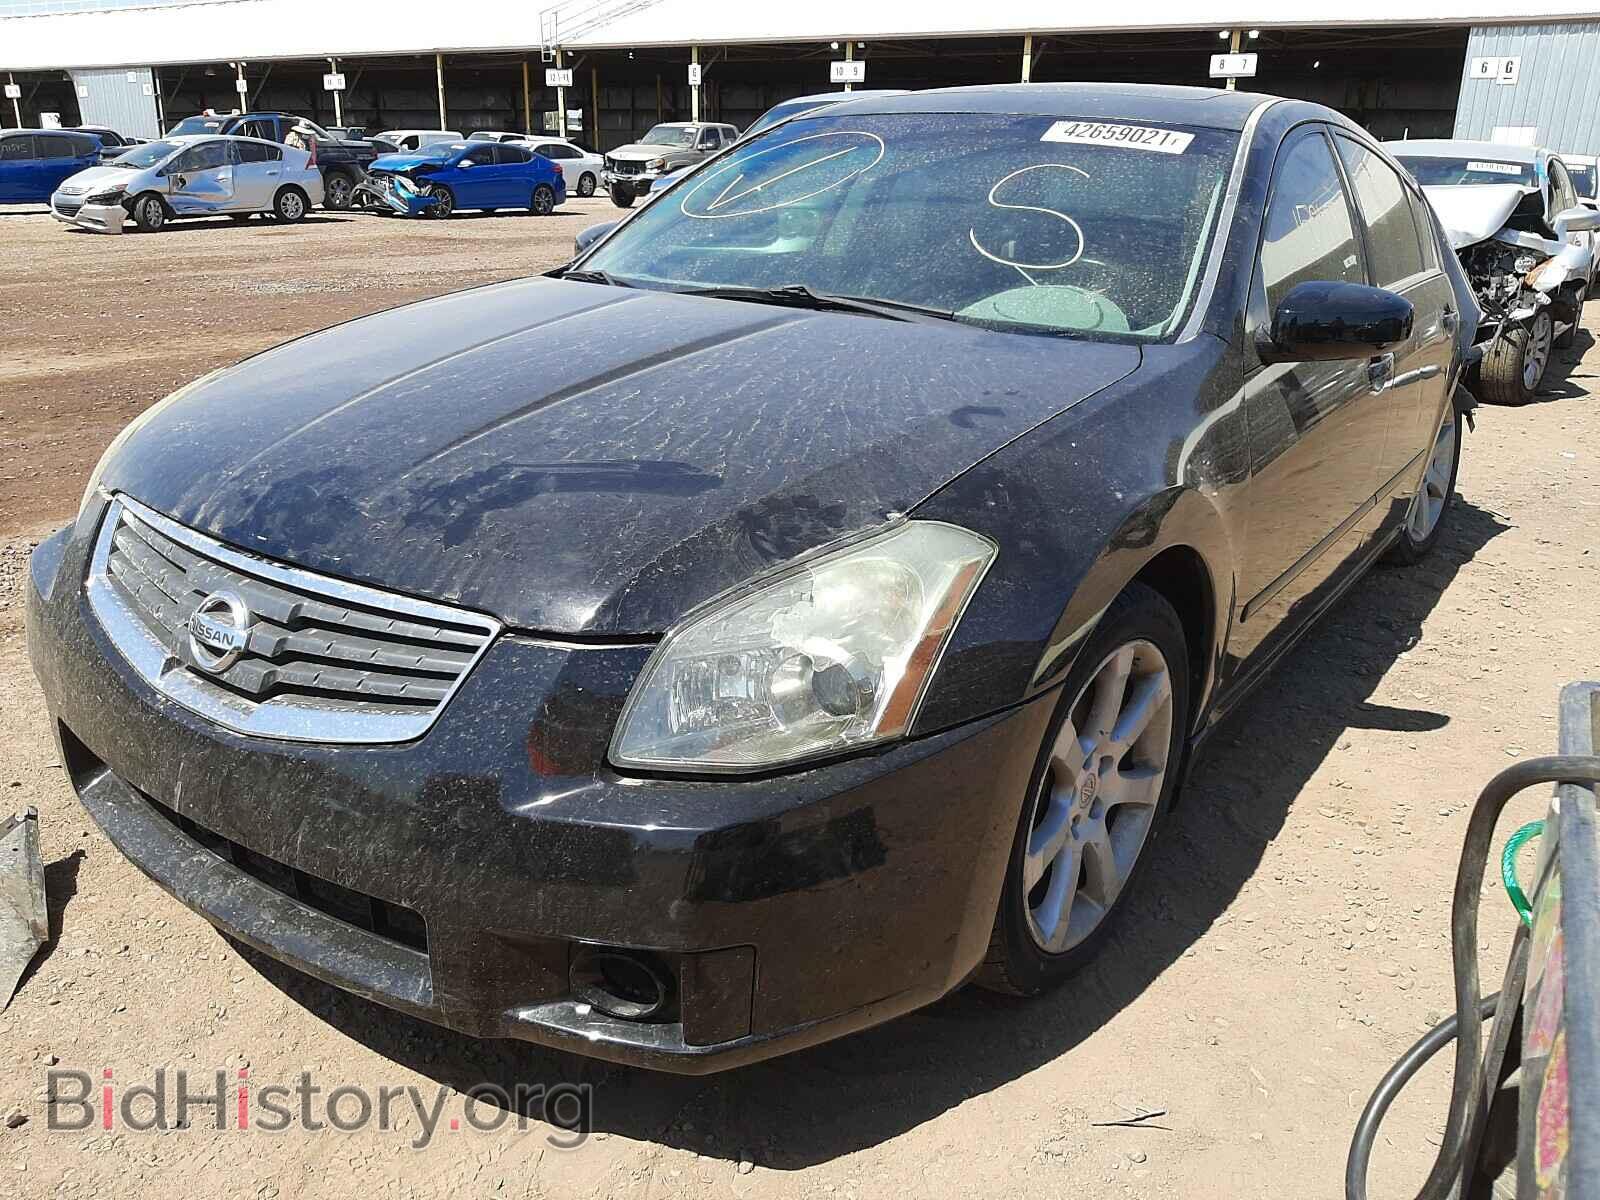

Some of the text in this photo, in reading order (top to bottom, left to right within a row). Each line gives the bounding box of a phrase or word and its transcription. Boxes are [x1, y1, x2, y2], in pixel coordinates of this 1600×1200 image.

[1219, 59, 1225, 70] 8
[1481, 61, 1488, 74] 6
[1064, 123, 1171, 146] 42659021
[190, 615, 234, 646] NISSAN
